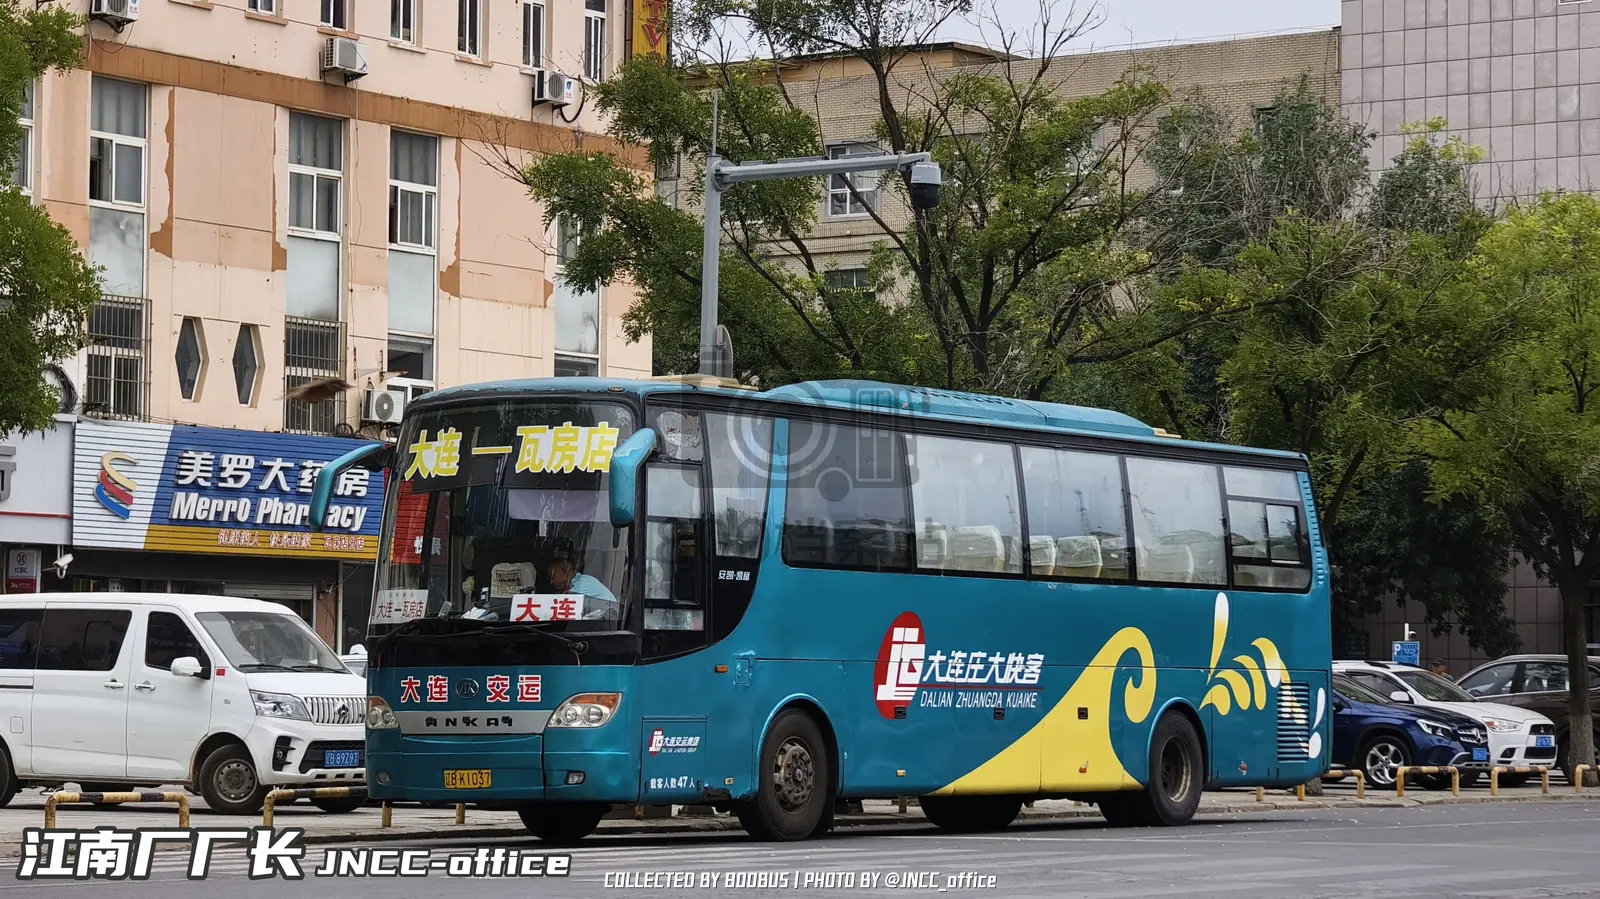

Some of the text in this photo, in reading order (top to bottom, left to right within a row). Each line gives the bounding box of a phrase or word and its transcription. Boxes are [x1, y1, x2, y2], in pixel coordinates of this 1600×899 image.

[256, 496, 368, 532] Pharacy
[515, 597, 577, 623] 大连
[400, 674, 542, 703] 大连 交运
[920, 690, 1038, 708] DALIAN ZHUANGDA KUAIKE
